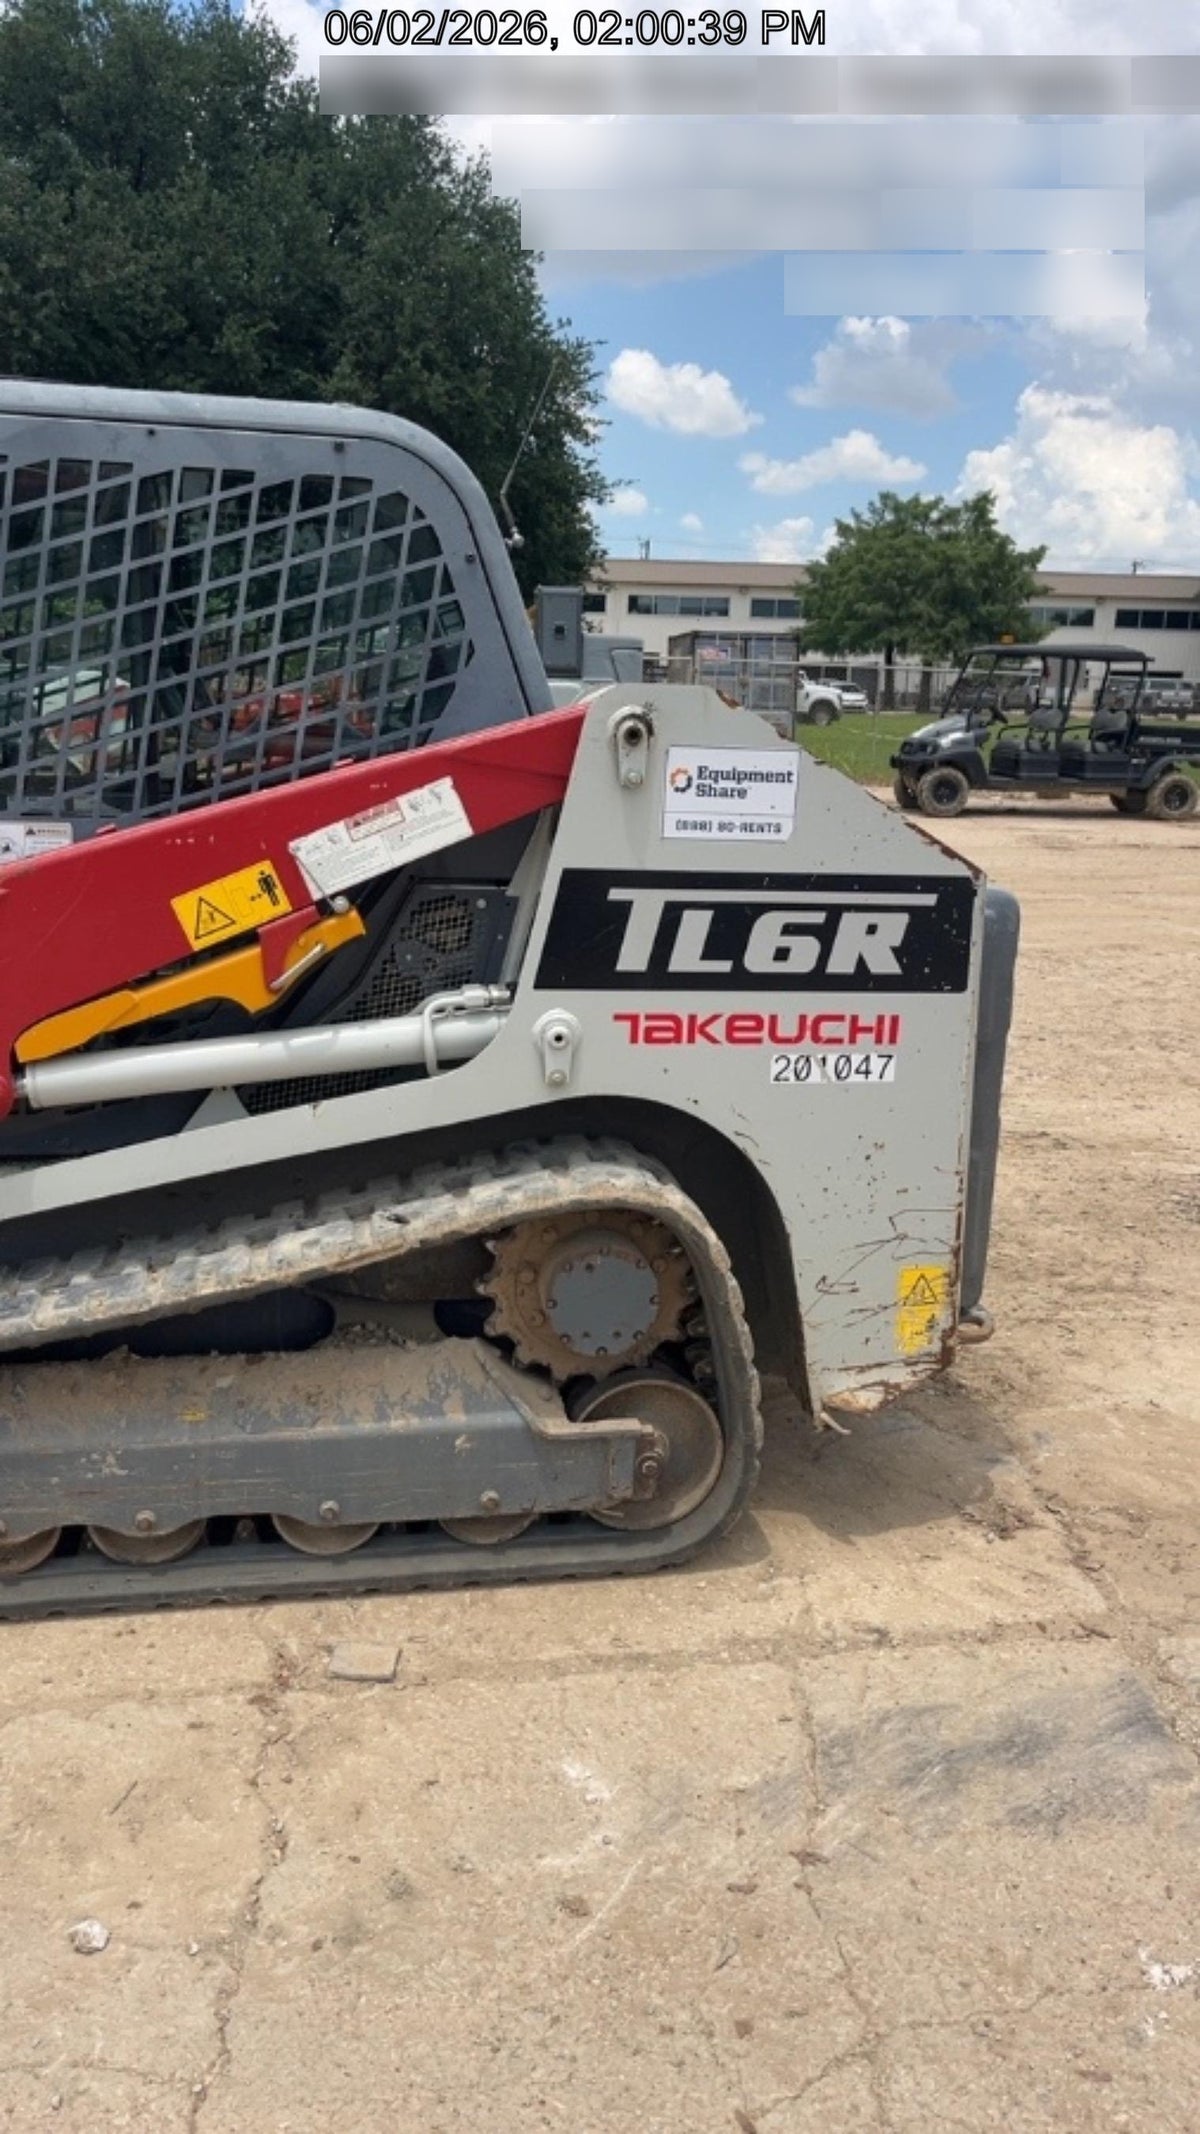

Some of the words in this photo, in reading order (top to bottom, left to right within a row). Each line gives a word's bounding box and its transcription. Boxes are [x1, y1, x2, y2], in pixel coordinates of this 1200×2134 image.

[697, 765, 794, 785] Equipment
[695, 783, 748, 799] Share
[607, 888, 938, 975] TL6R
